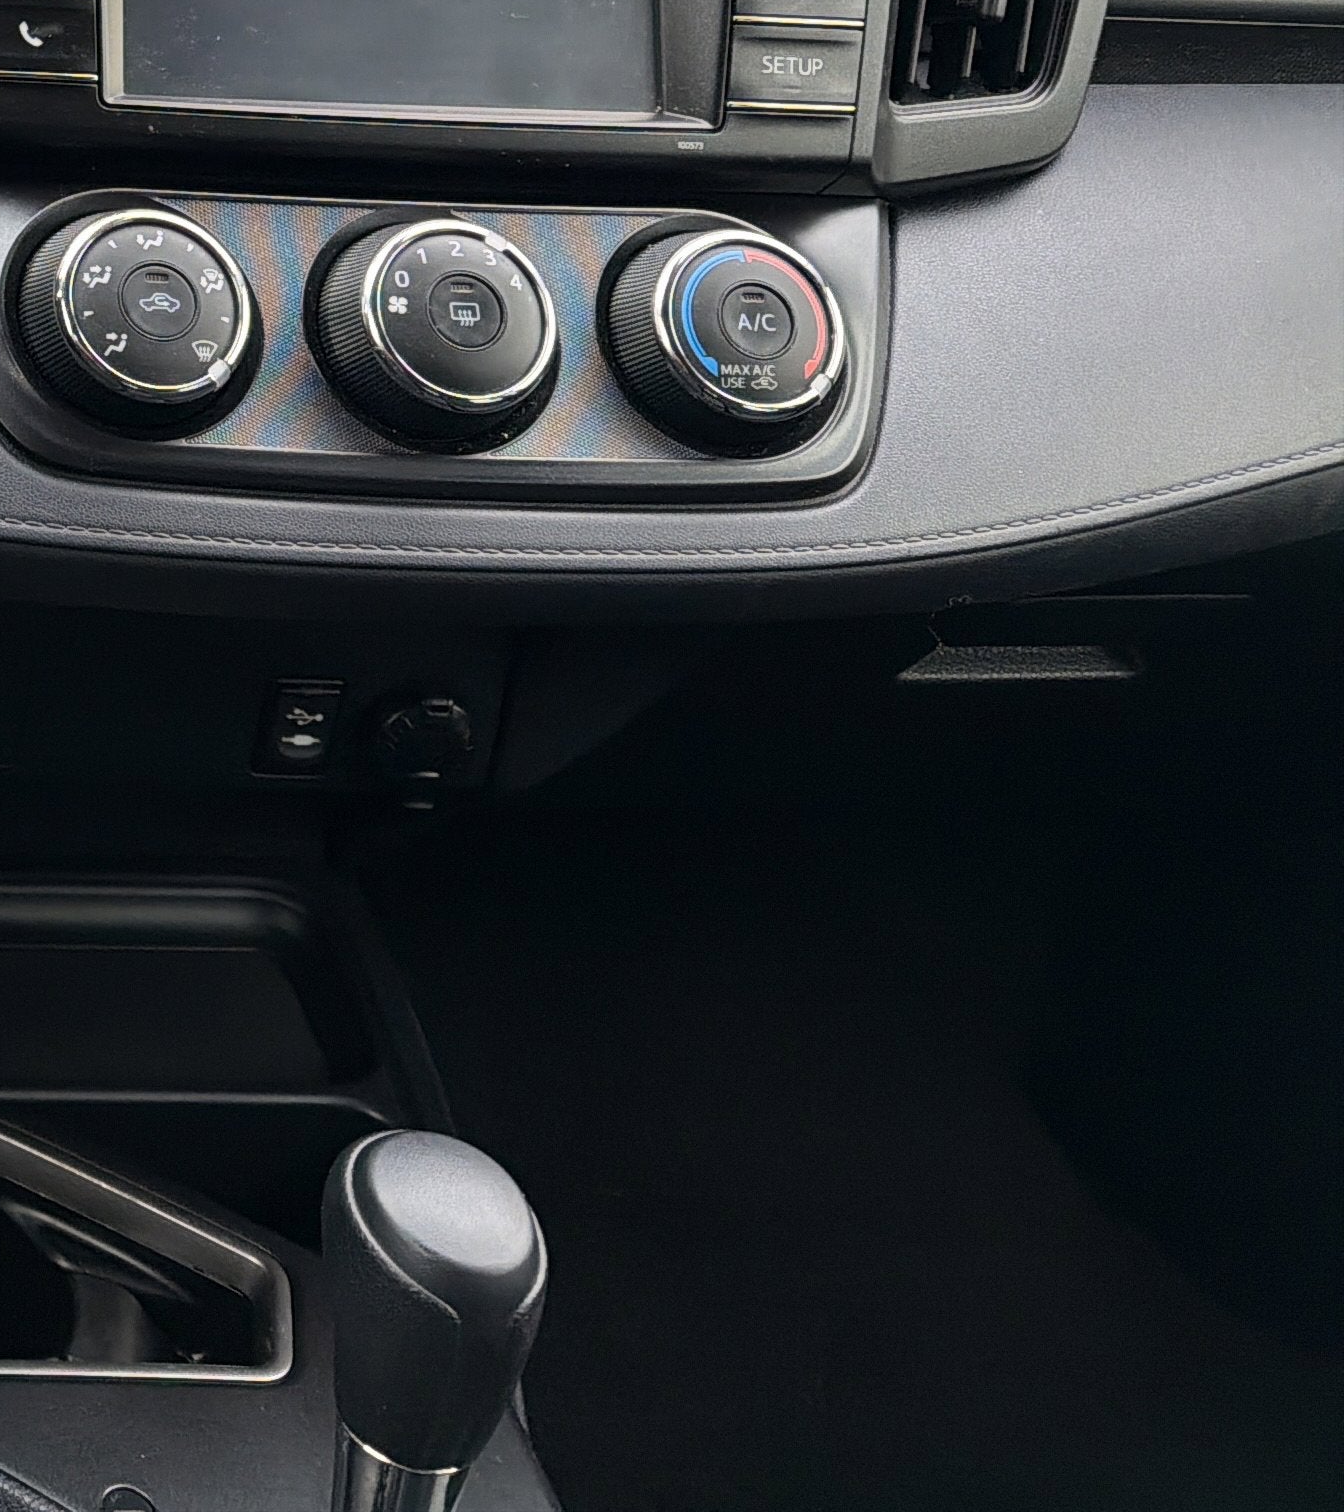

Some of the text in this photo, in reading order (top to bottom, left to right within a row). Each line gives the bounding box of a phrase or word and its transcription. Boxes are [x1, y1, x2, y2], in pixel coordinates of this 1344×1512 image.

[762, 55, 824, 77] SETUP
[417, 248, 427, 264] 1
[448, 241, 464, 257] 2
[484, 249, 497, 266] 3
[395, 270, 409, 287] 0
[510, 274, 522, 291] 4
[738, 313, 777, 332] A/C
[720, 365, 777, 376] MAX A/C
[720, 377, 746, 388] USE
